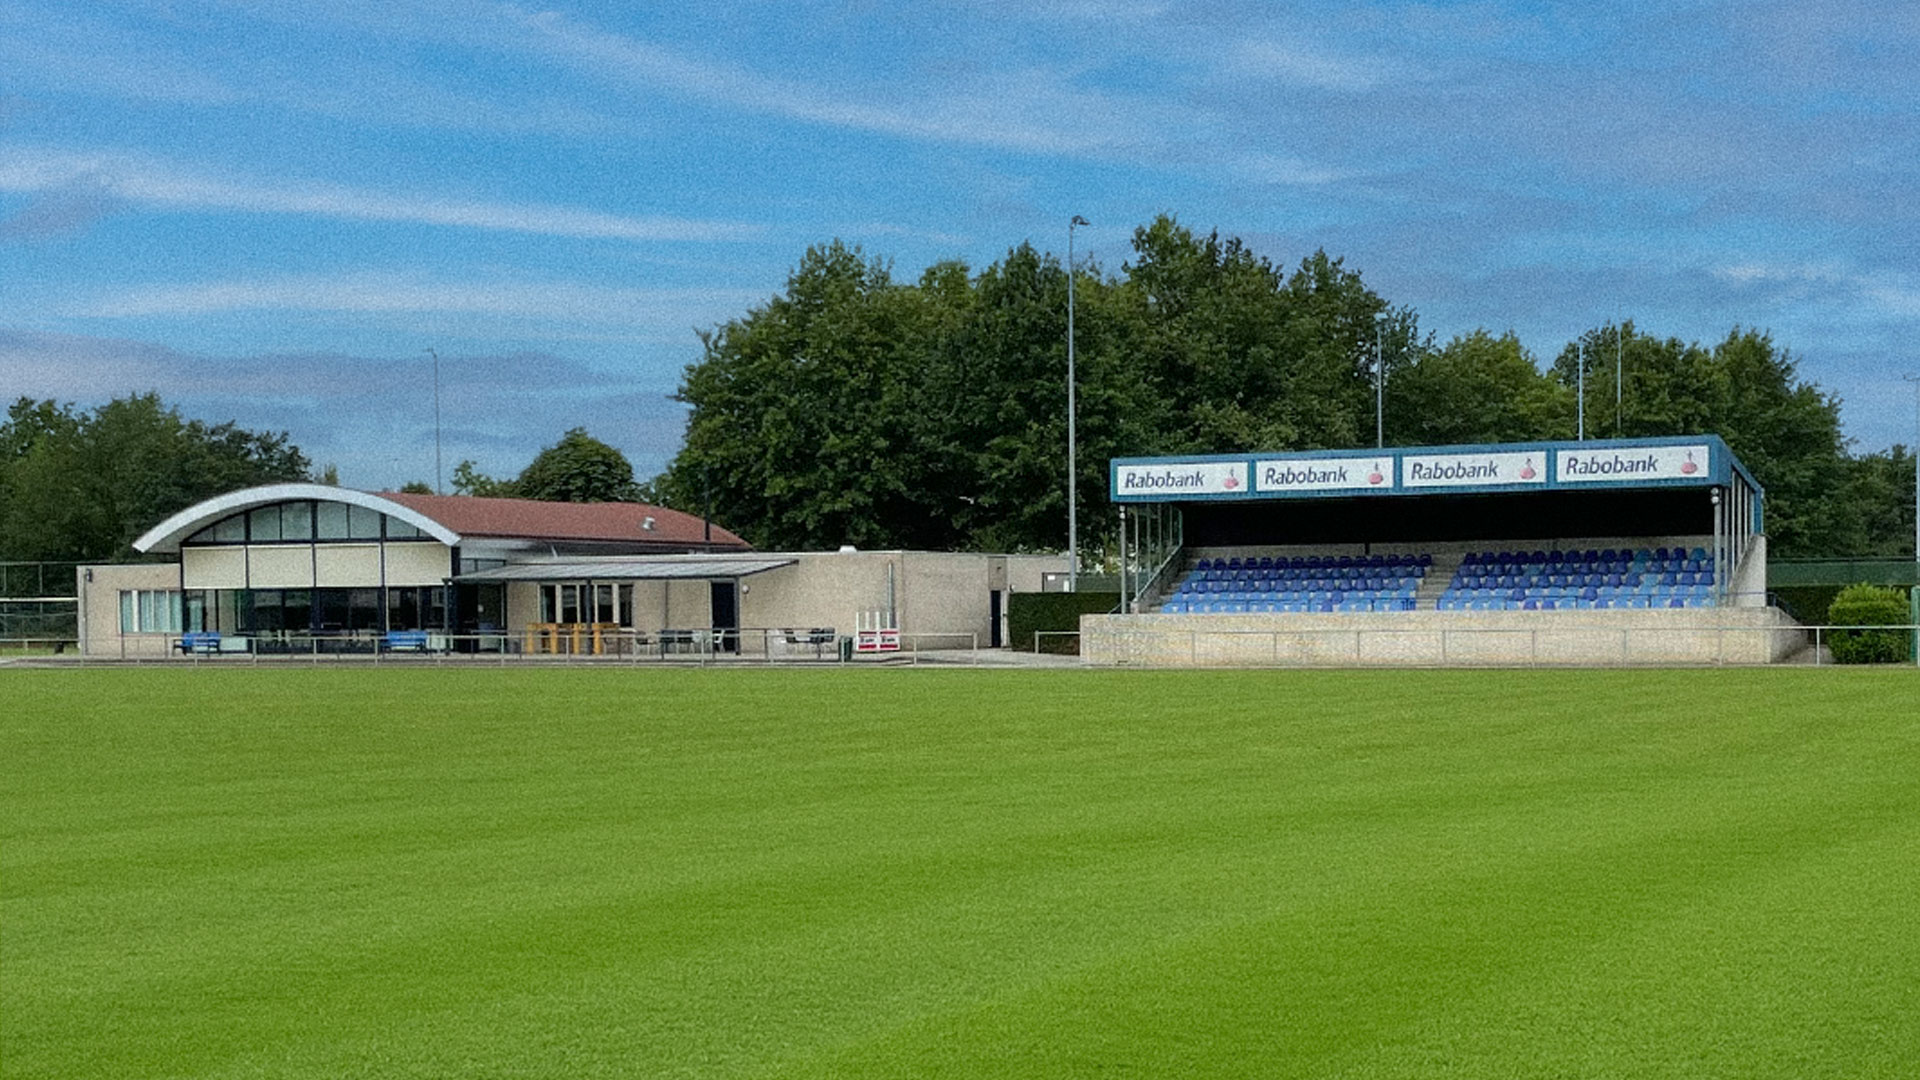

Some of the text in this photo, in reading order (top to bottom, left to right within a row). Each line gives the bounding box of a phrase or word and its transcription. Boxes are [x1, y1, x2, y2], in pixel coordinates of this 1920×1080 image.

[1411, 461, 1498, 480] Rabobank
[1566, 455, 1658, 475] Rabobank
[1125, 470, 1204, 488] Rabobank
[1265, 466, 1348, 485] Rabobank
